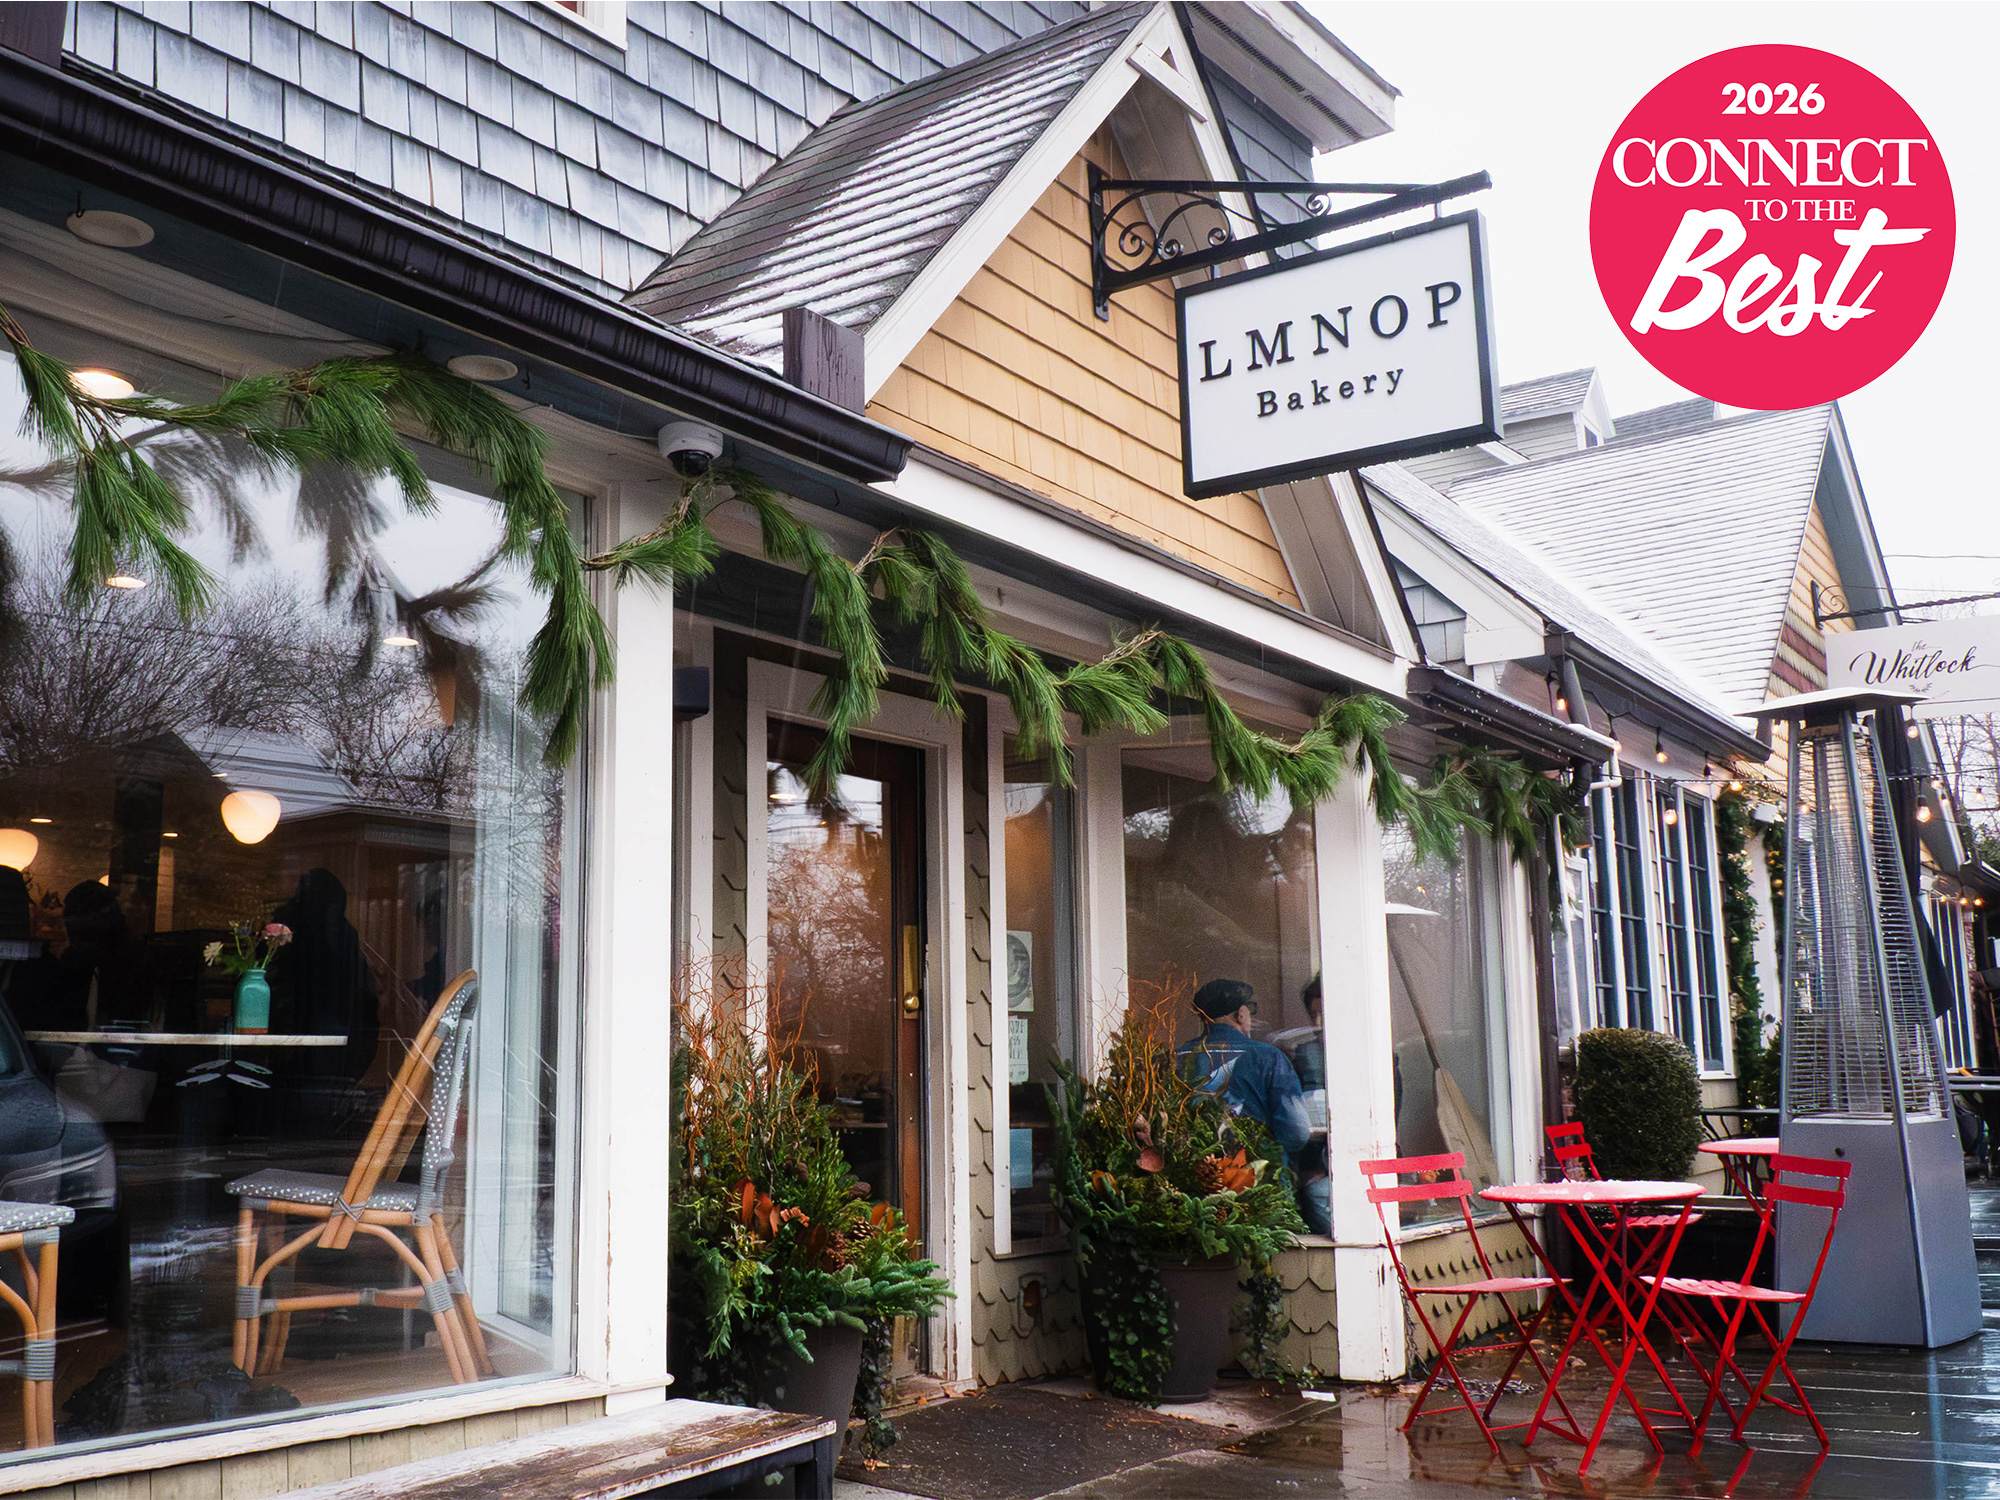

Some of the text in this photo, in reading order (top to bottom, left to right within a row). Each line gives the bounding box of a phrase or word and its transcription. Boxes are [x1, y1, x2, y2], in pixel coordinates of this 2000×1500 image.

[1198, 280, 1462, 383] LMNOP
[1256, 368, 1404, 418] Bakery
[1848, 645, 1986, 686] Whitlock
[1911, 639, 1936, 652] the
